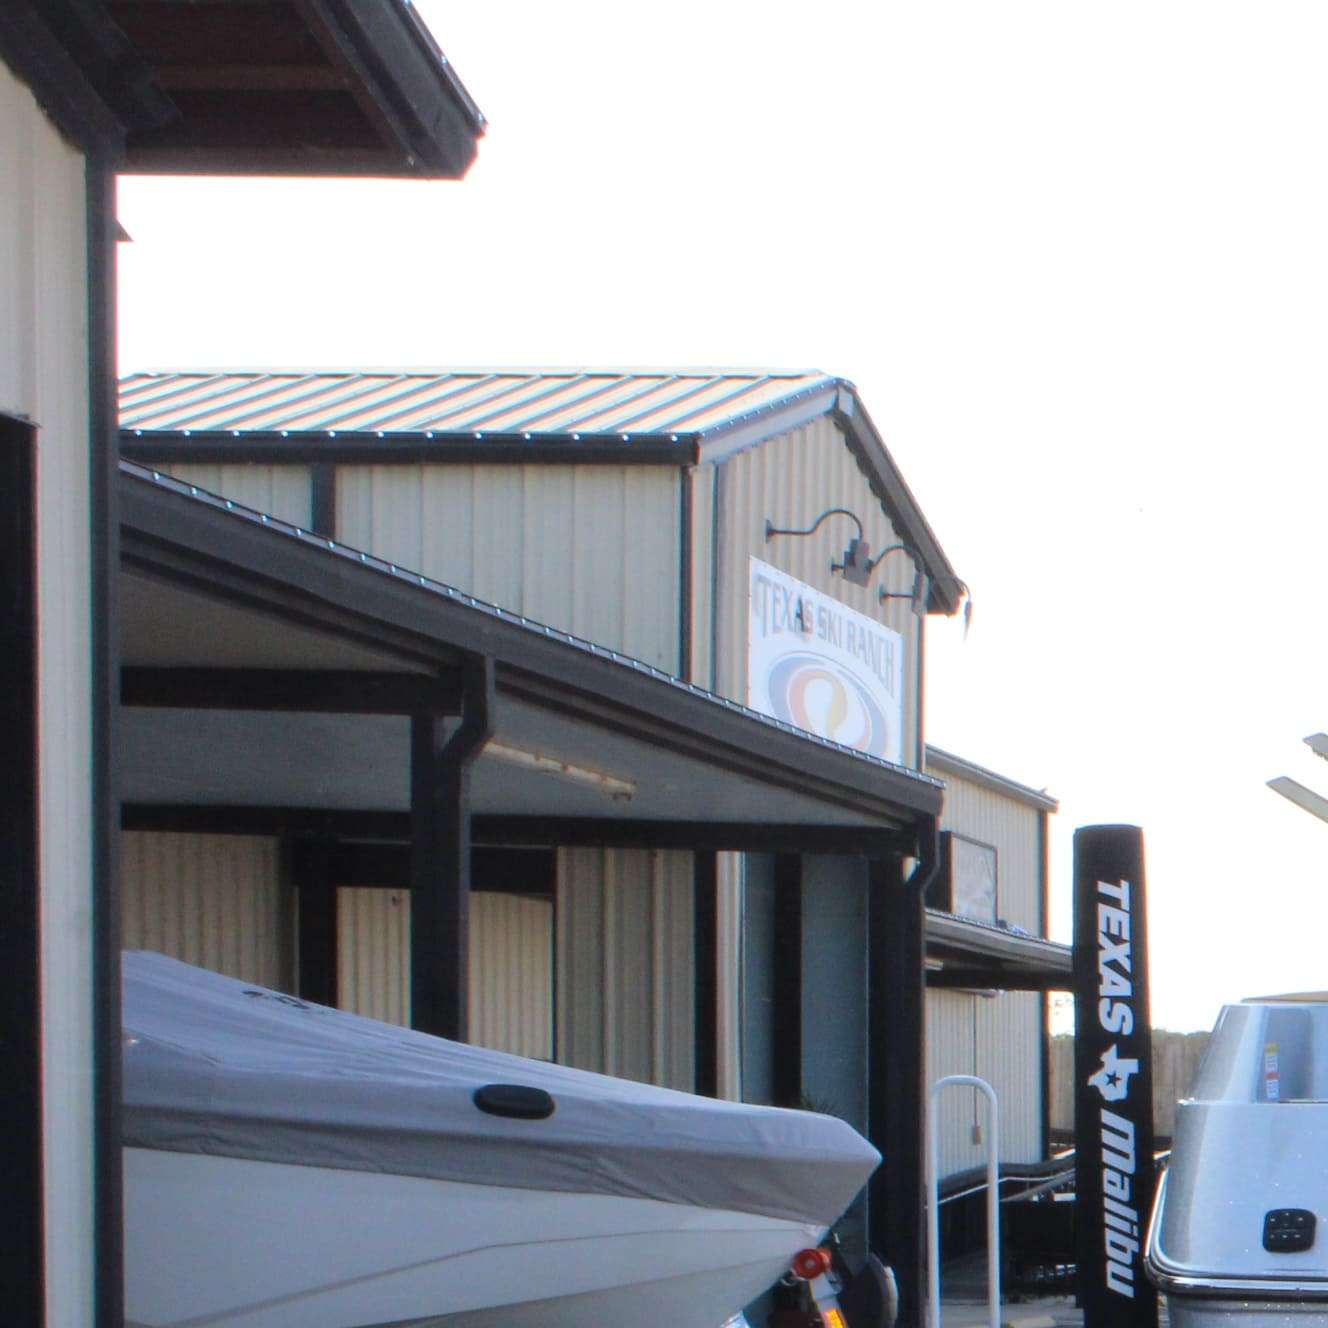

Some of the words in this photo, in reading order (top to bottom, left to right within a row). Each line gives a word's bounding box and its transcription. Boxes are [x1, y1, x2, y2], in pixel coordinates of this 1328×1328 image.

[757, 573, 814, 640] TEXAS
[818, 604, 842, 650] SKI
[847, 619, 896, 699] RANCH
[1098, 880, 1133, 1035] TEXAS
